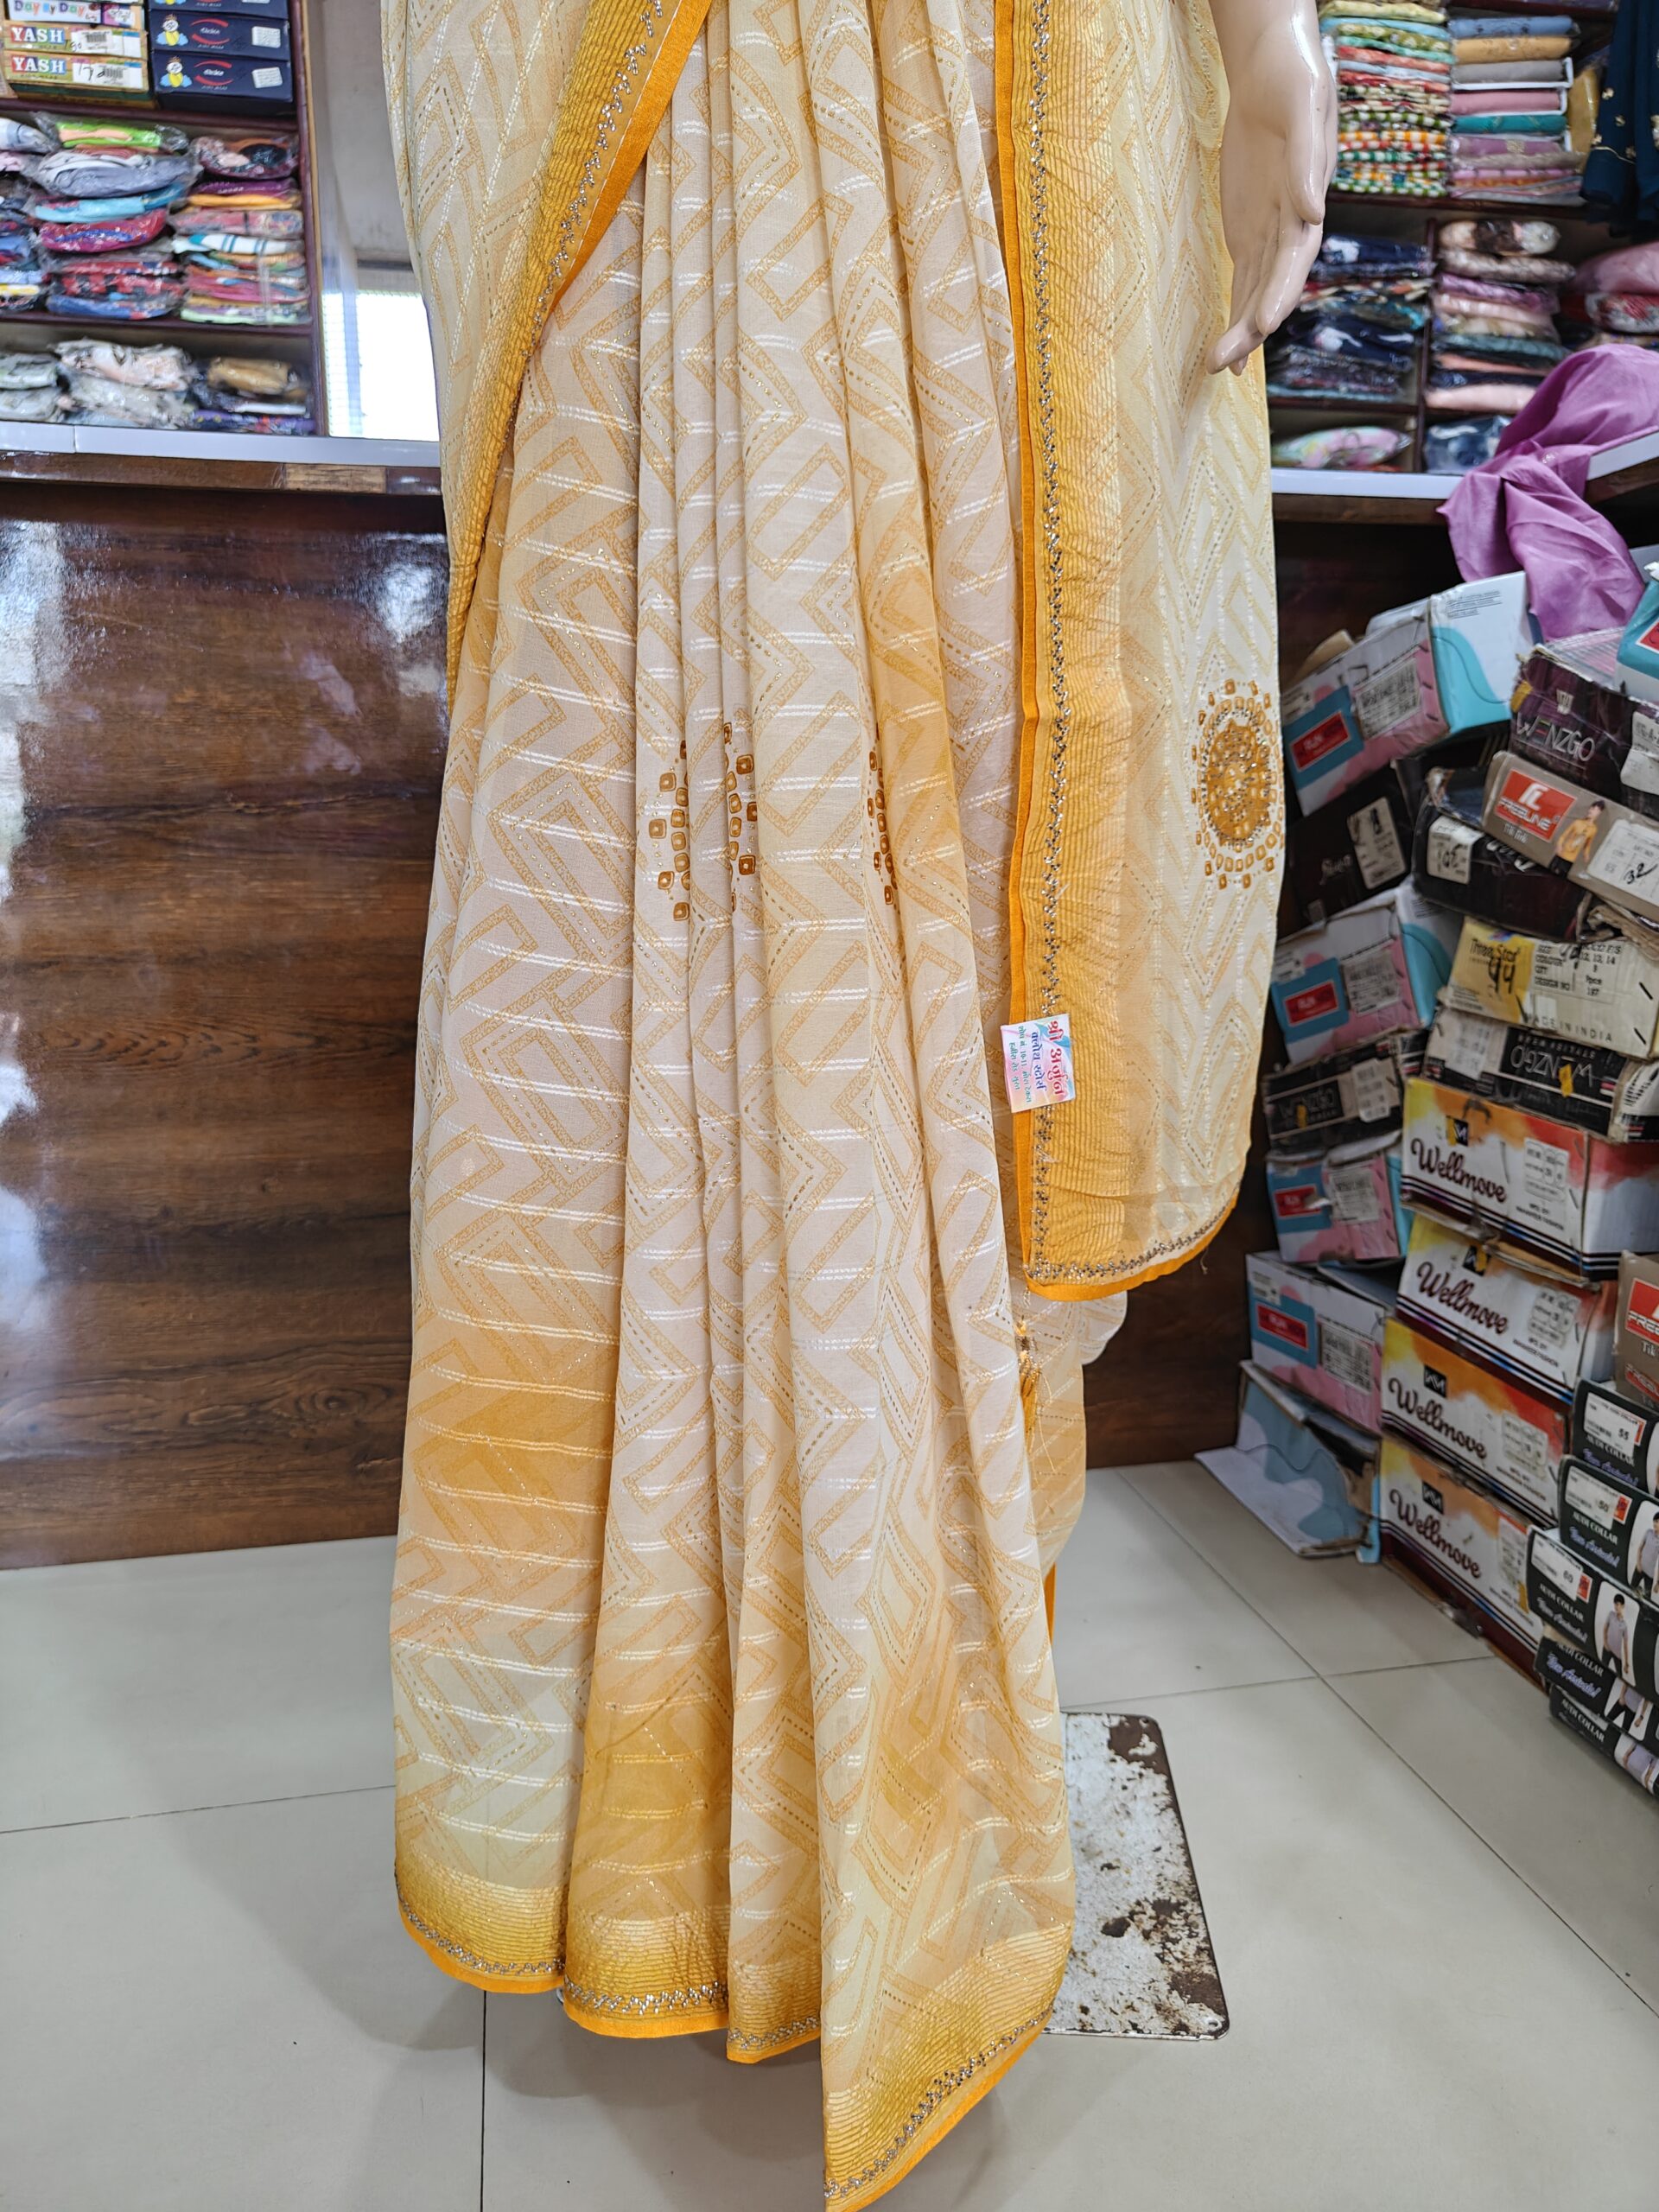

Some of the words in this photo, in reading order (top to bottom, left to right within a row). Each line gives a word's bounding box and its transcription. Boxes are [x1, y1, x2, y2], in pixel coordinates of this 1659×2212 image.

[14, 1, 40, 16] Day
[59, 3, 85, 16] Day
[11, 27, 65, 44] YASH
[12, 56, 67, 74] YASH
[1516, 712, 1595, 761] WENZGO
[1048, 1020, 1064, 1041] શ્રી
[1559, 1022, 1572, 1033] IN
[1575, 1025, 1613, 1042] INDIA
[1047, 1048, 1068, 1095] અર્જુન
[1511, 1045, 1593, 1088] WNZGO
[1411, 1138, 1507, 1203] Wellmove
[1417, 1262, 1508, 1334] Wellmove
[1388, 1377, 1487, 1459] Wellmove
[1389, 1489, 1482, 1578] Wellmove
[1590, 1521, 1618, 1545] COLLAR
[1556, 1595, 1584, 1623] COLLAR
[1574, 1650, 1605, 1677] COLLAR
[1577, 1713, 1605, 1743] COLLAR
